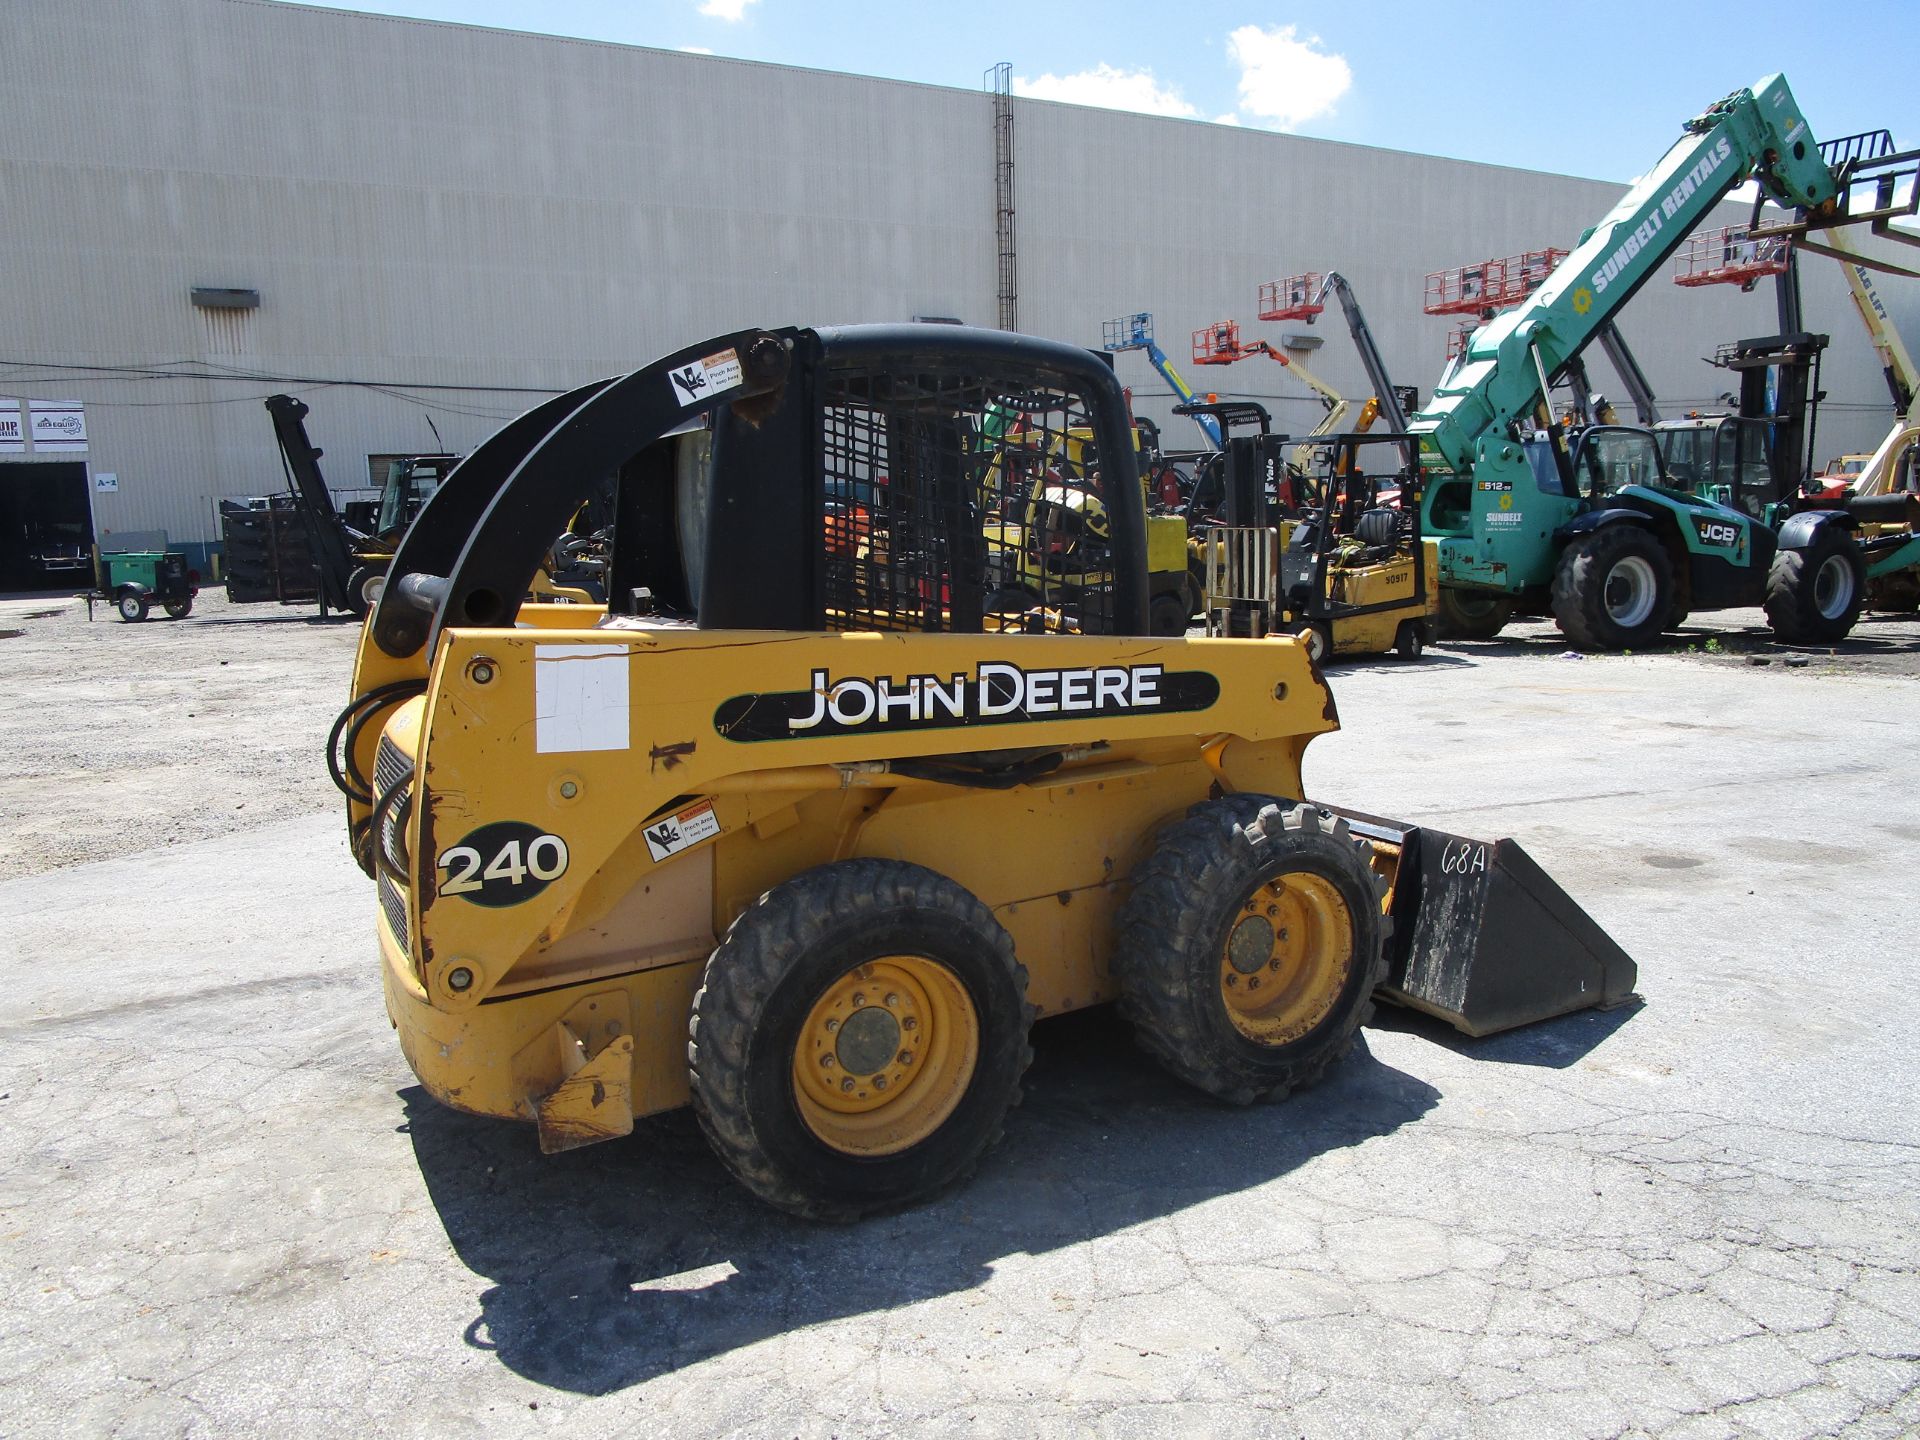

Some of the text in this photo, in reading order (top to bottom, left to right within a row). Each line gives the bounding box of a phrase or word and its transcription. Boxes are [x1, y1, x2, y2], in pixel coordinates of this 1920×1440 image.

[1591, 136, 1732, 294] SUNBELT RENTALS
[1855, 266, 1888, 321] JLG LIFT
[709, 365, 739, 380] Pinch Area
[1265, 458, 1274, 482] Yale
[97, 479, 116, 487] A-2
[1485, 512, 1523, 522] SUNBELT
[1700, 523, 1735, 542] JCB
[553, 596, 570, 605] CAT
[788, 664, 1163, 730] JOHN DEERE
[684, 816, 713, 832] Pinch Area
[438, 833, 570, 897] 240
[1440, 839, 1486, 874] 68A
